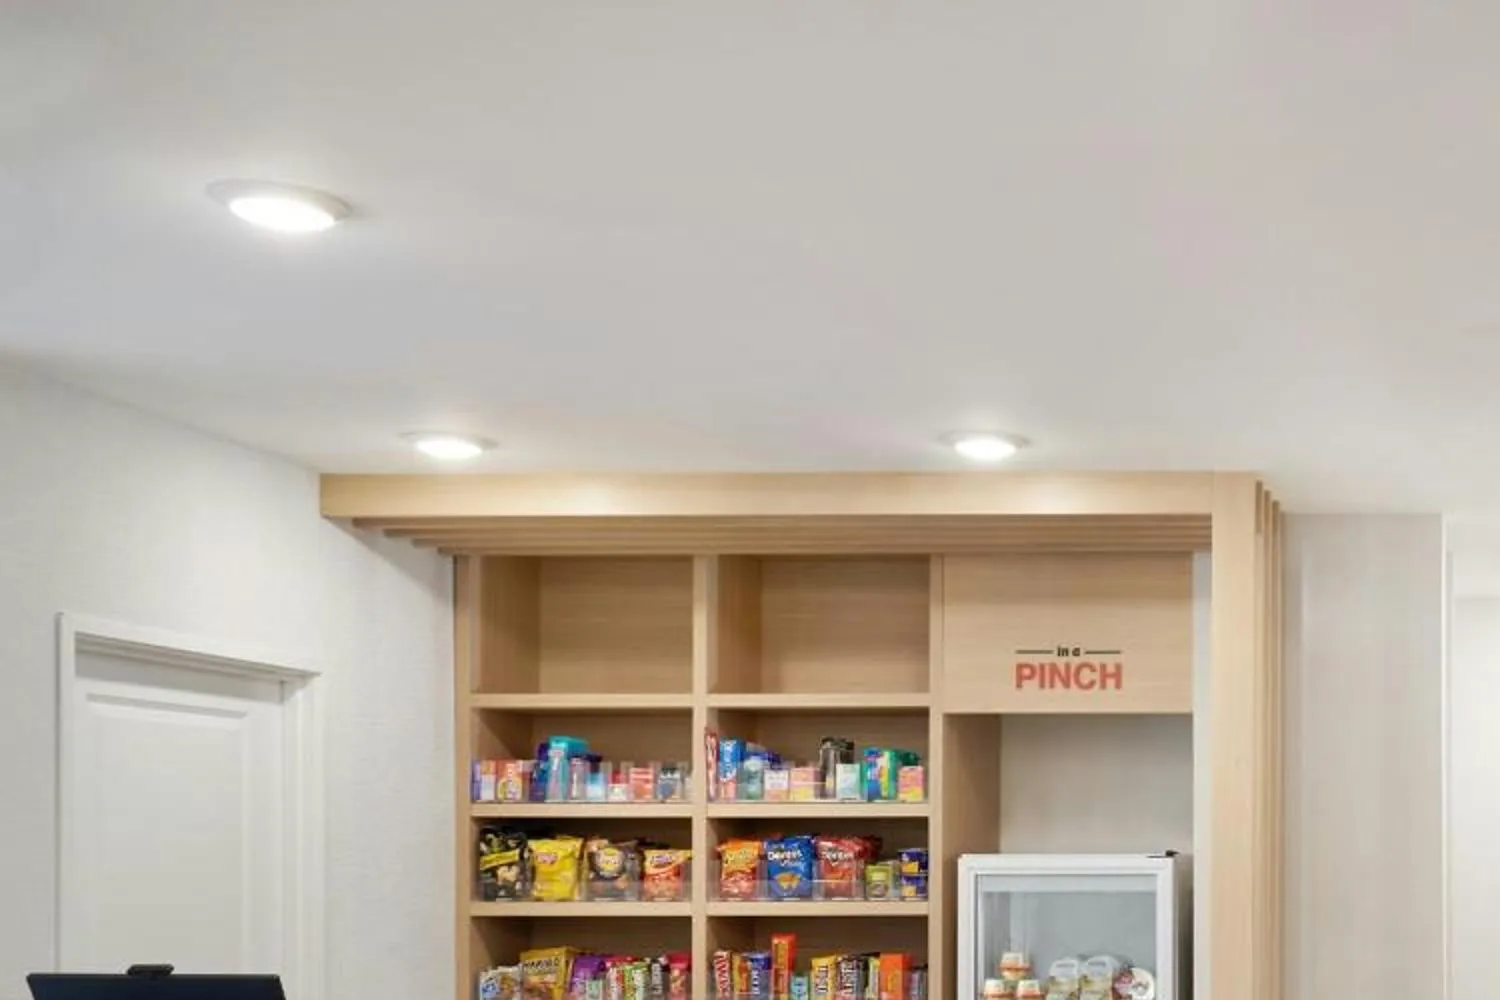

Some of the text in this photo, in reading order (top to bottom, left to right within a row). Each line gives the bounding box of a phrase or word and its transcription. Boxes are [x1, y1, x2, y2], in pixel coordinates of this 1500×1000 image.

[1057, 646, 1081, 657] in a
[1015, 662, 1123, 690] PINCH
